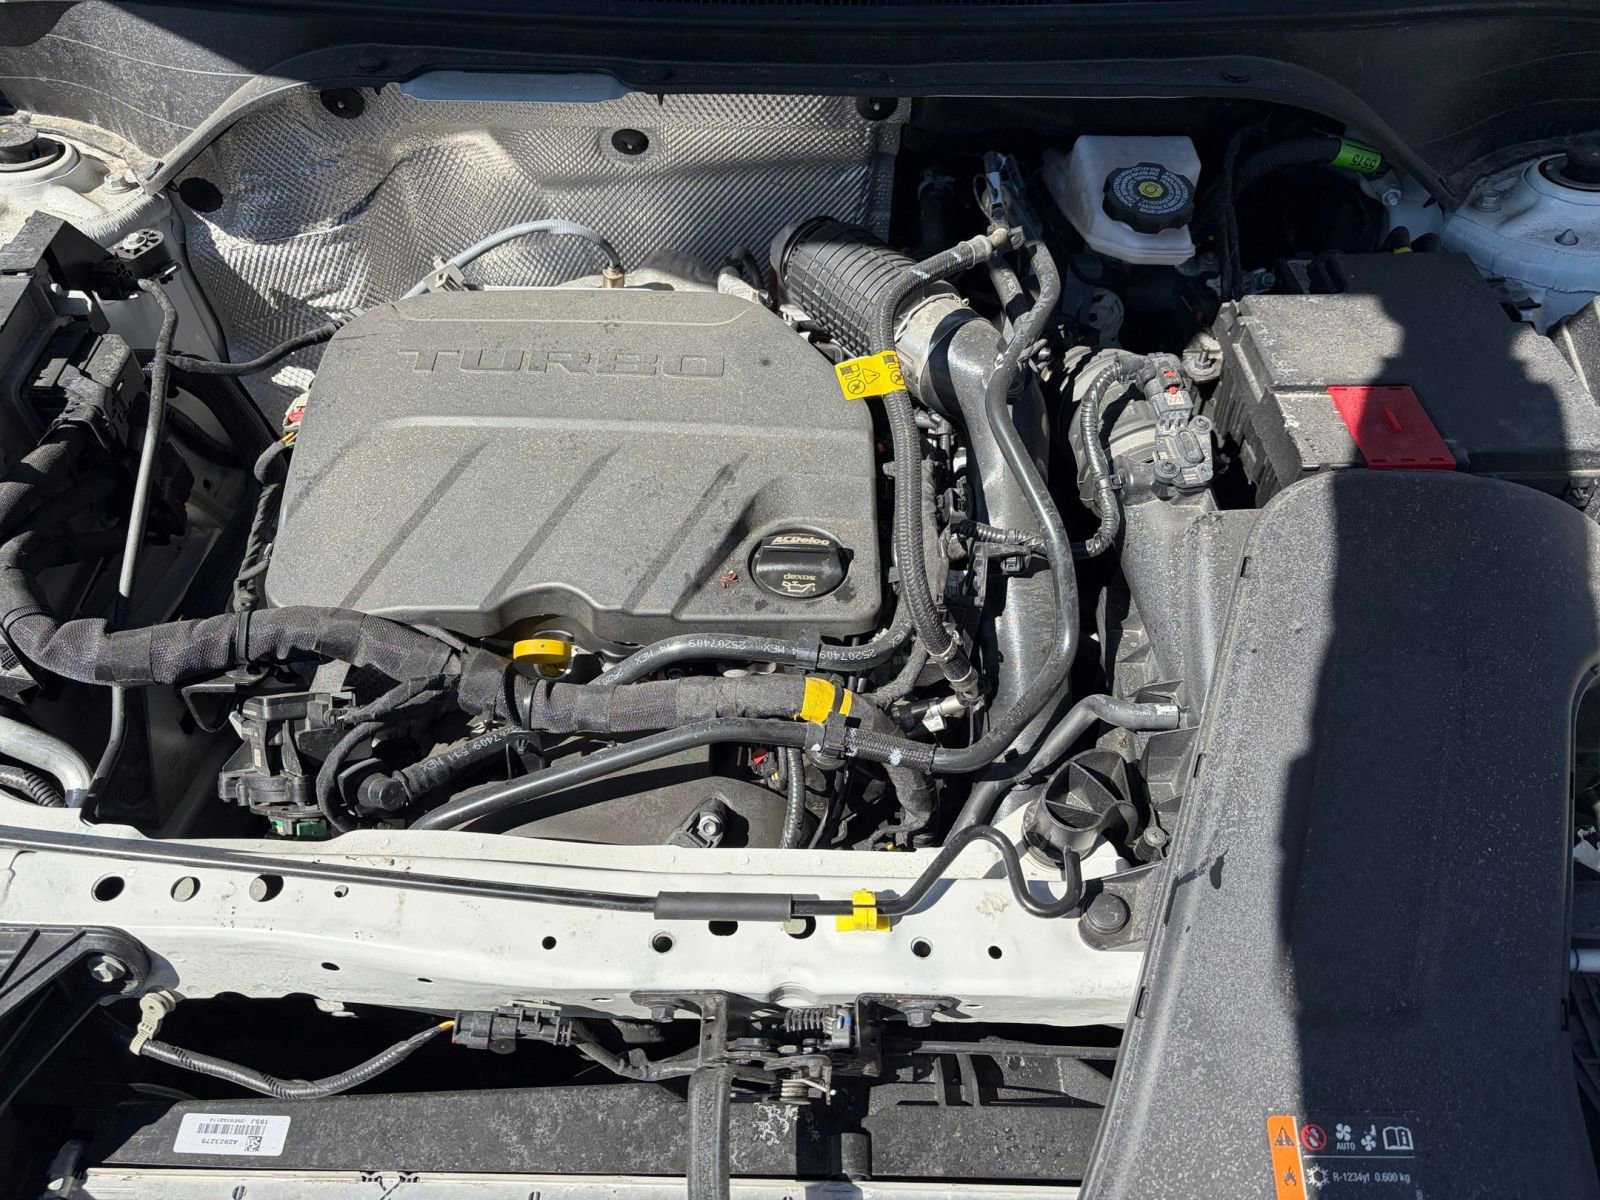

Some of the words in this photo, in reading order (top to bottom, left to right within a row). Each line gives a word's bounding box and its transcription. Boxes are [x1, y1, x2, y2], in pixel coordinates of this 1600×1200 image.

[399, 349, 725, 379] TURBO
[770, 536, 830, 546] ACDelco
[688, 639, 746, 650] 25207409
[888, 630, 906, 647] MEX
[763, 644, 785, 654] MEX
[819, 648, 877, 661] 25207409
[634, 649, 654, 665] MEX
[1336, 1142, 1356, 1151] AUTO
[1374, 1172, 1397, 1182] 0.600
[1399, 1172, 1411, 1184] kg
